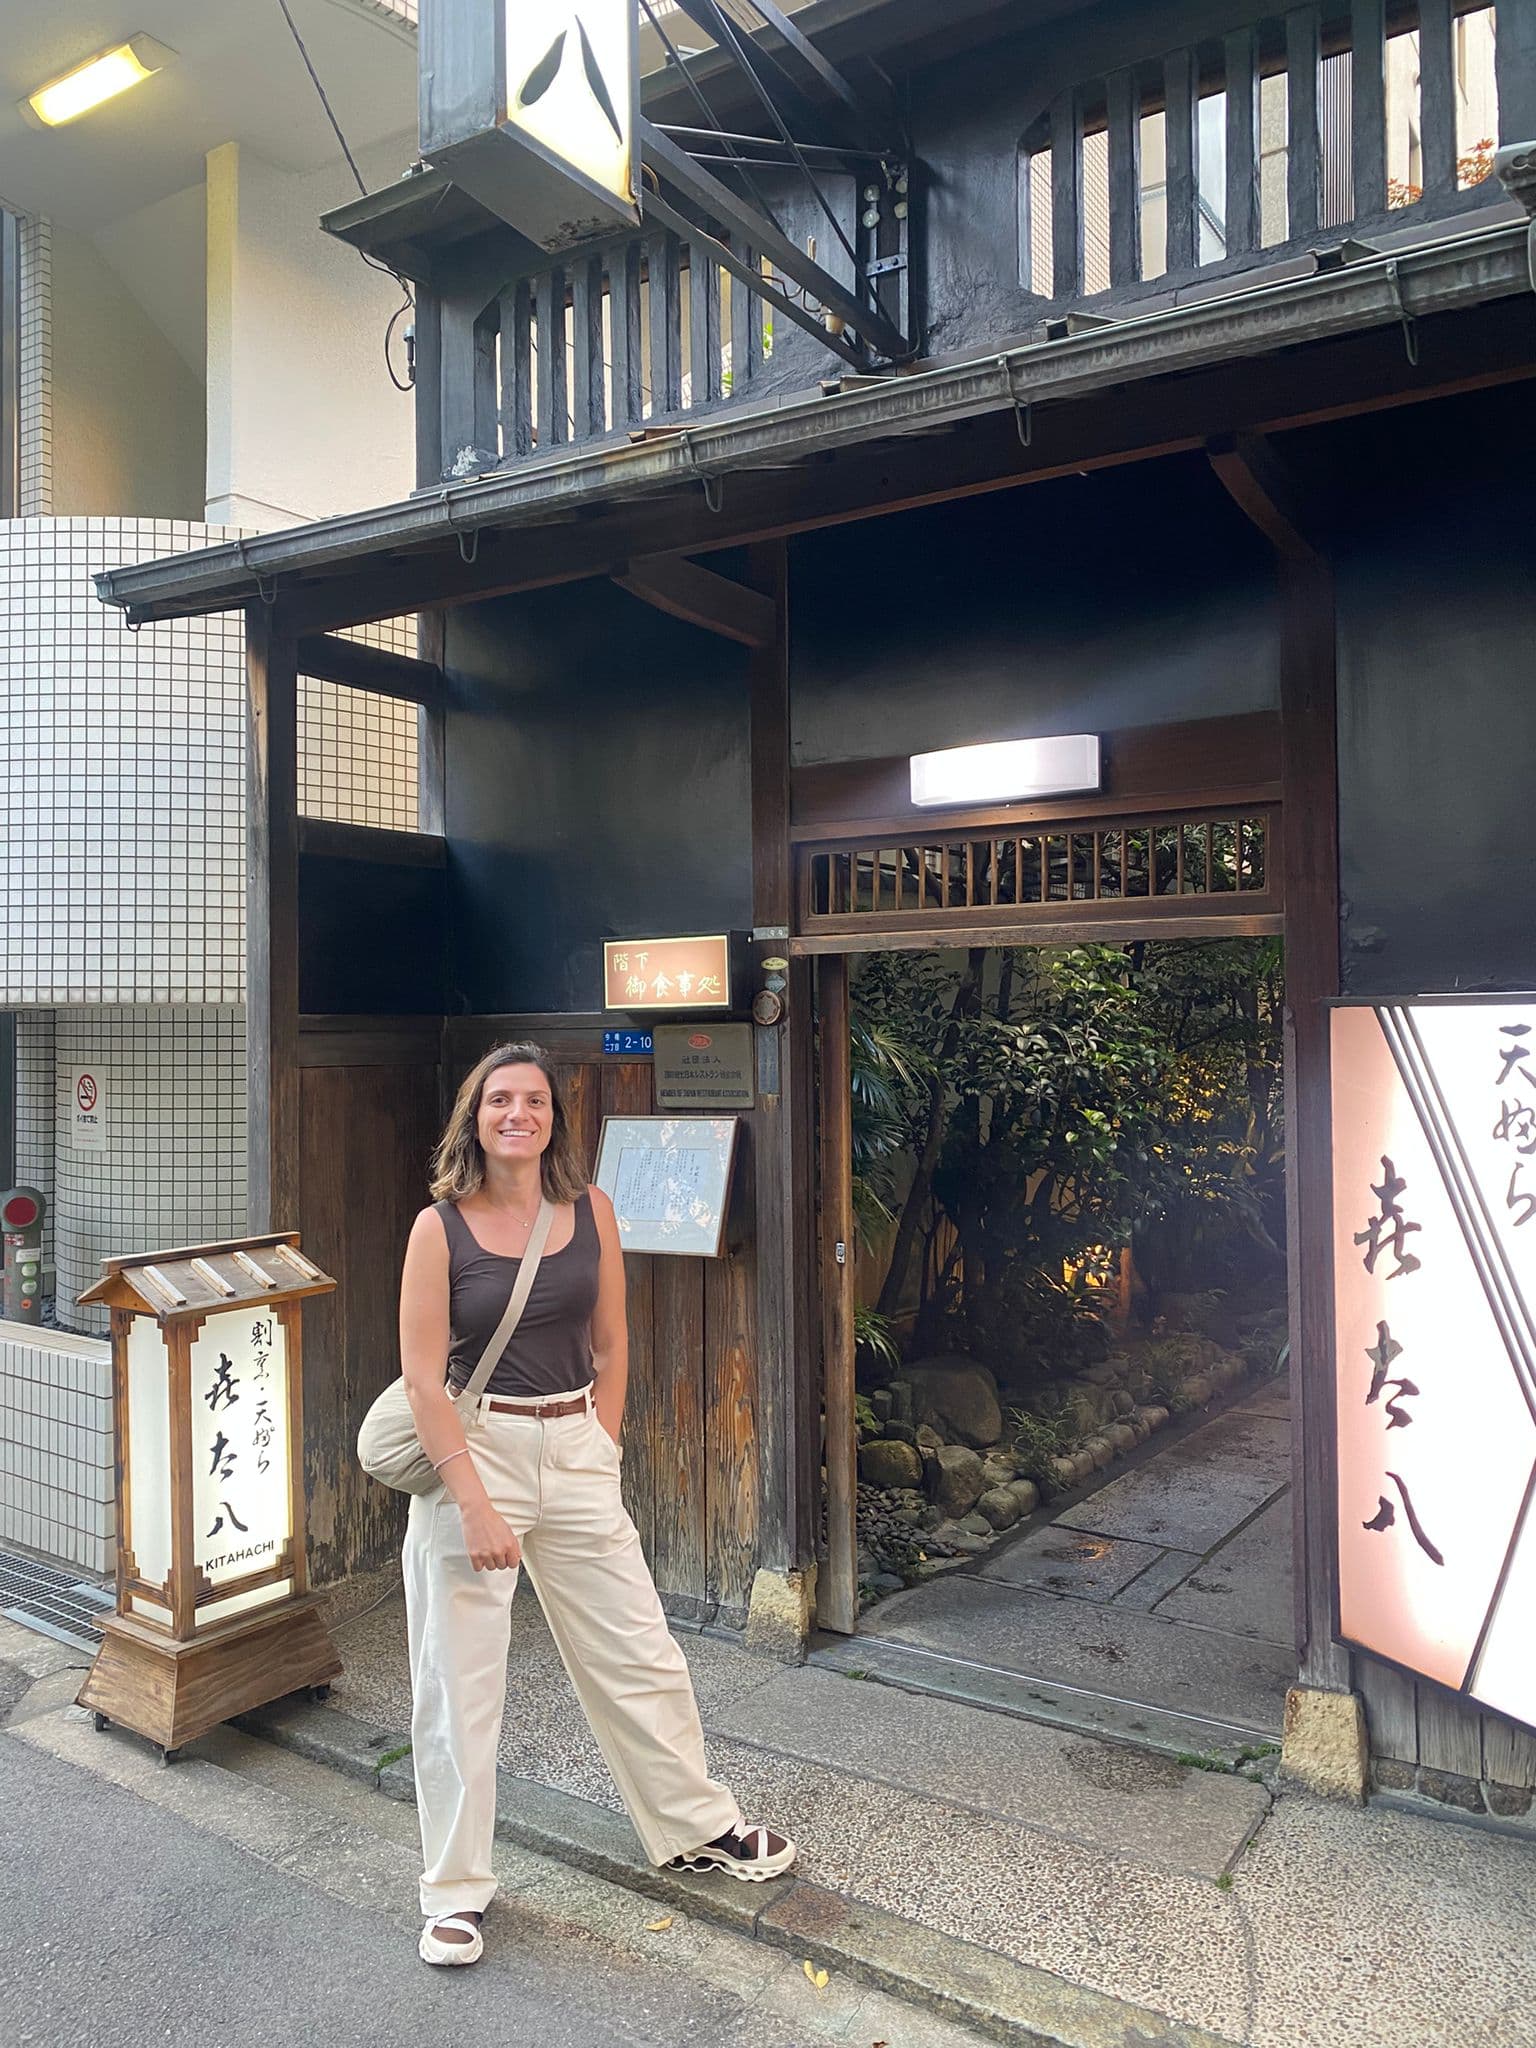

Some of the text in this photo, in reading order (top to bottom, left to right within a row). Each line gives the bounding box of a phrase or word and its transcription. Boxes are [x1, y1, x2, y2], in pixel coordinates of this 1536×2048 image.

[613, 951, 649, 972] 階下
[625, 970, 720, 1000] 御食事処
[624, 1036, 652, 1049] 2-10
[205, 1540, 275, 1572] KITAHACHI
